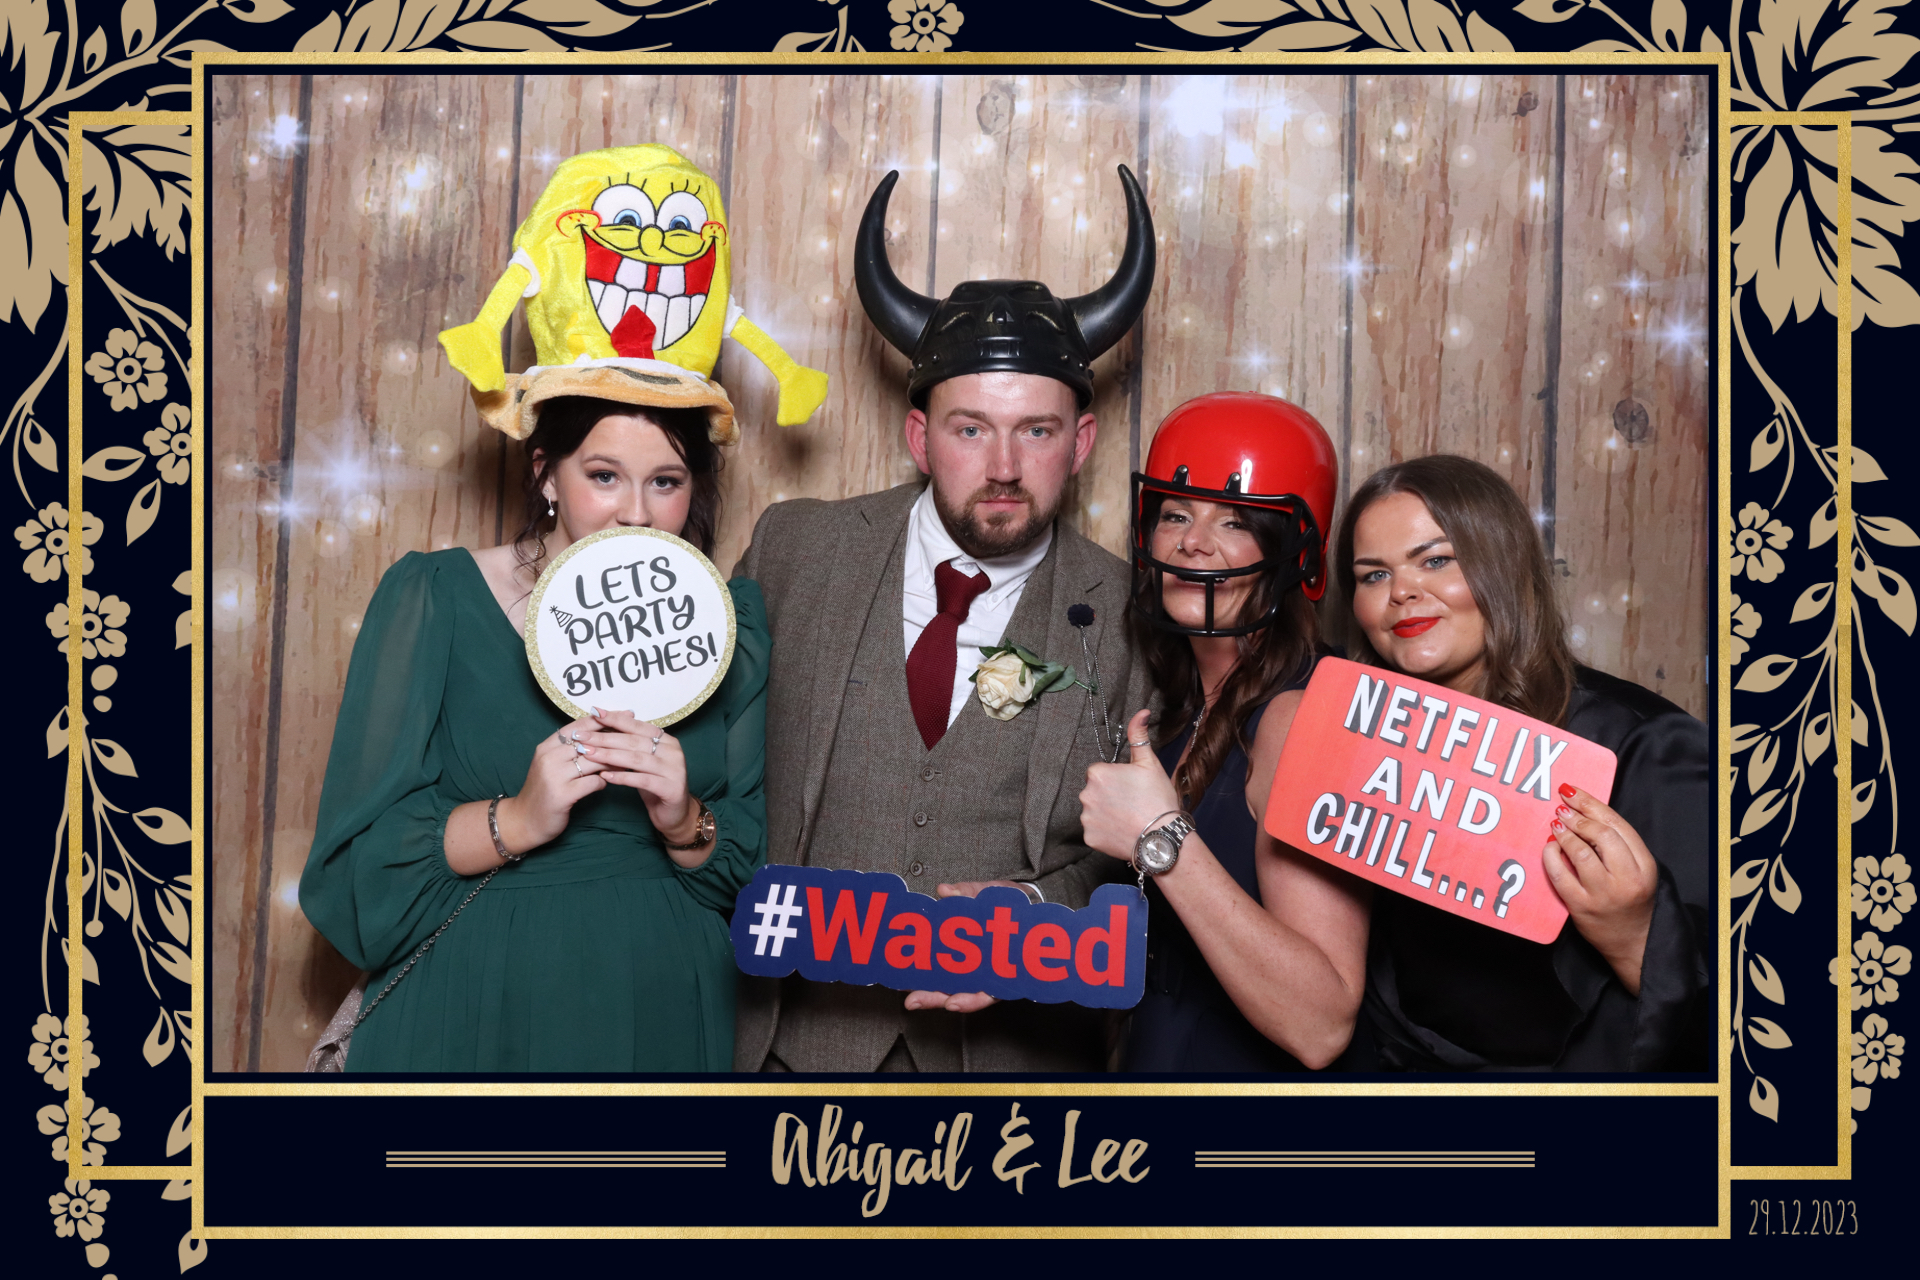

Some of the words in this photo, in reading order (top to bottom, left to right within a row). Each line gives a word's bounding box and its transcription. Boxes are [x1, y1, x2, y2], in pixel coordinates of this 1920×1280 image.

[575, 556, 677, 610] LETS
[562, 632, 719, 697] BITCHES!
[564, 594, 695, 656] PARTY
[1343, 673, 1569, 801] NETFLIX
[1361, 756, 1501, 836] AND
[1306, 792, 1527, 919] CHILL...?
[748, 883, 1129, 988] #Wasted
